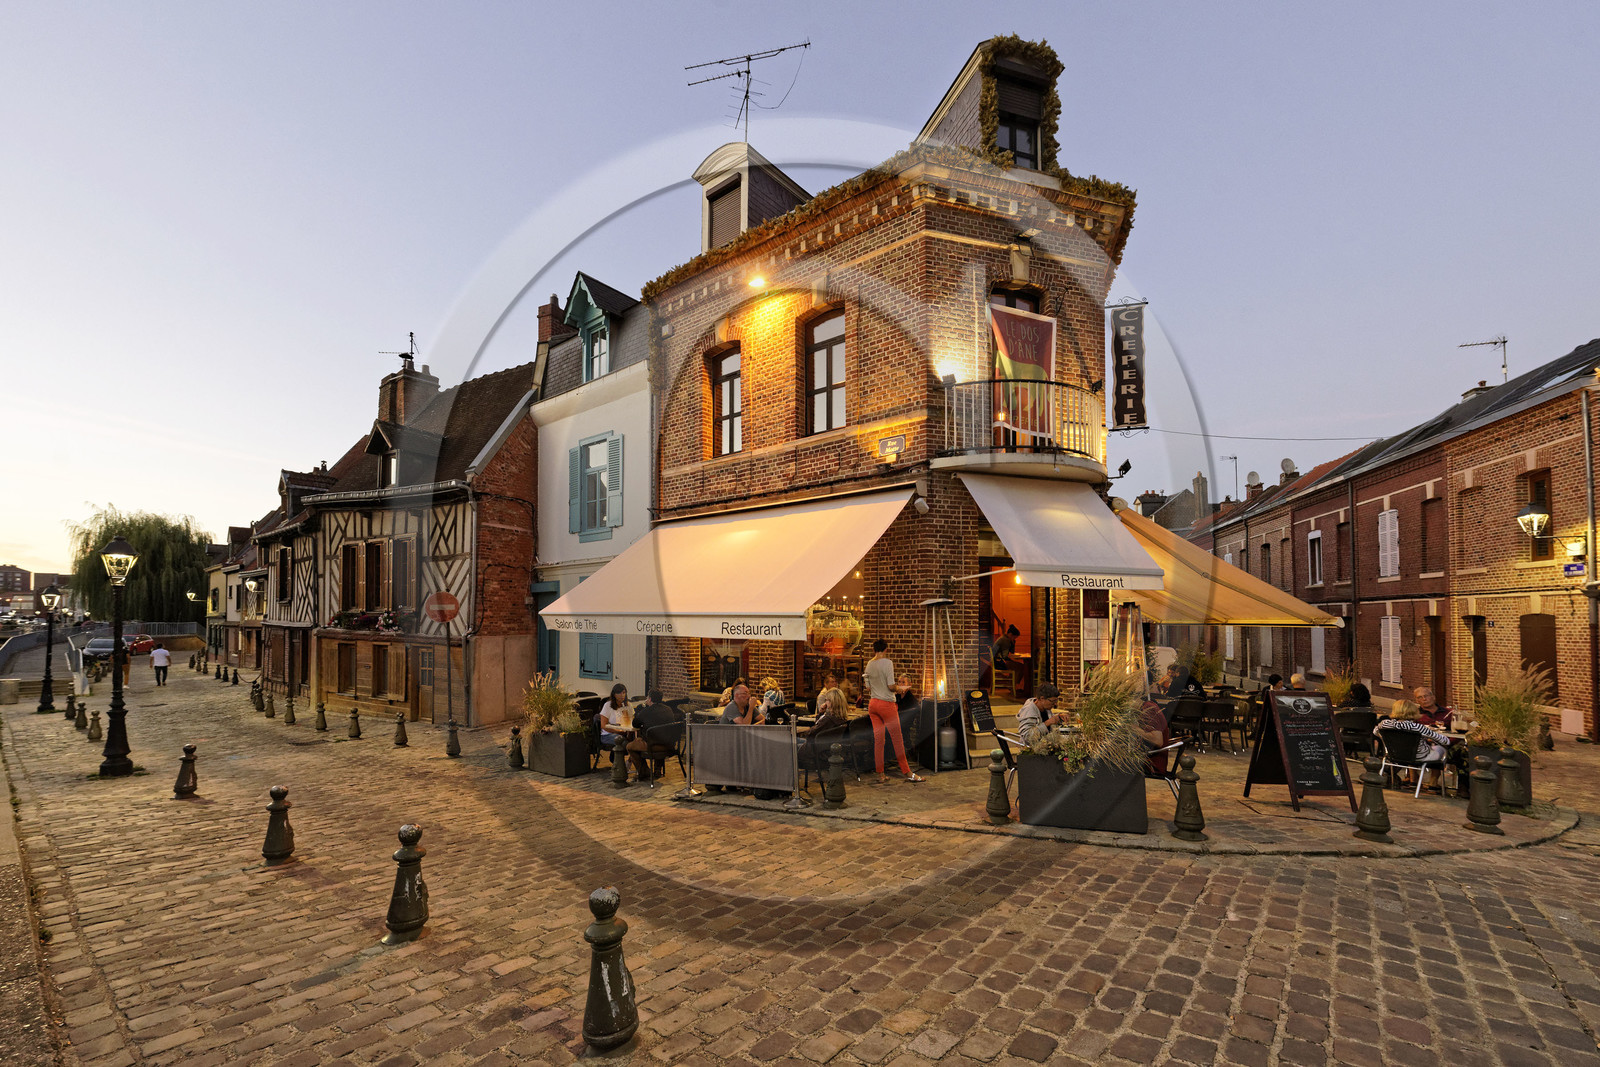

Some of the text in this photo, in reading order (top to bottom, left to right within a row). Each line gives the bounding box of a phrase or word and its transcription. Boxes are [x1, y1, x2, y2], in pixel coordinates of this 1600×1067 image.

[1005, 320, 1040, 343] LE DOS
[1009, 339, 1038, 361] D'ÂNE
[1119, 310, 1139, 424] CREPERIE
[1061, 574, 1124, 588] Restaurant
[554, 618, 598, 630] Salon de Thé
[636, 620, 673, 635] Créperie
[721, 621, 782, 636] Restaurant
